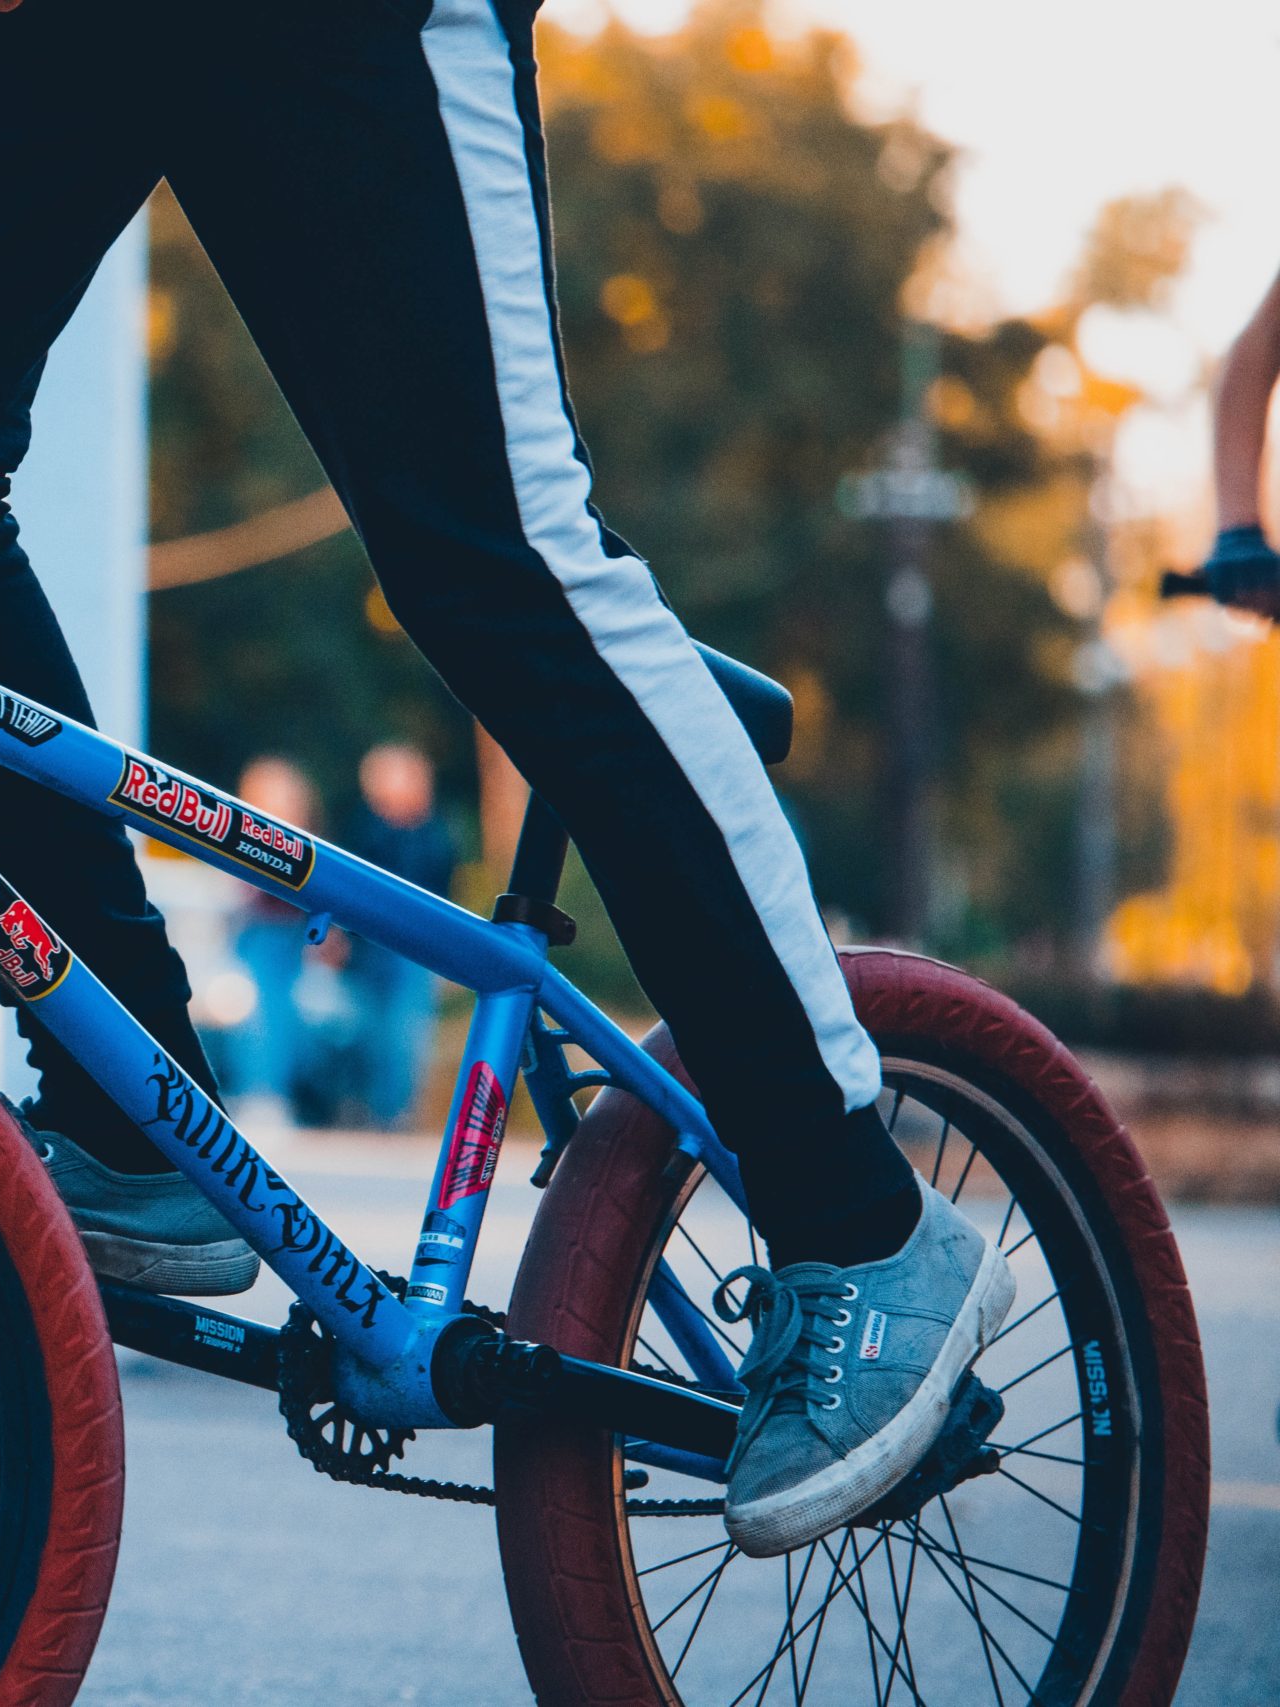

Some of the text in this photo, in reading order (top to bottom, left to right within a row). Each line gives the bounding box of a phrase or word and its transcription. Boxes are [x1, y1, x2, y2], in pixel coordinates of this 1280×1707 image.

[11, 698, 58, 738] TEAM
[235, 840, 293, 875] HONDA
[195, 1315, 245, 1344] MISSION
[869, 1313, 883, 1344] SUPERGA
